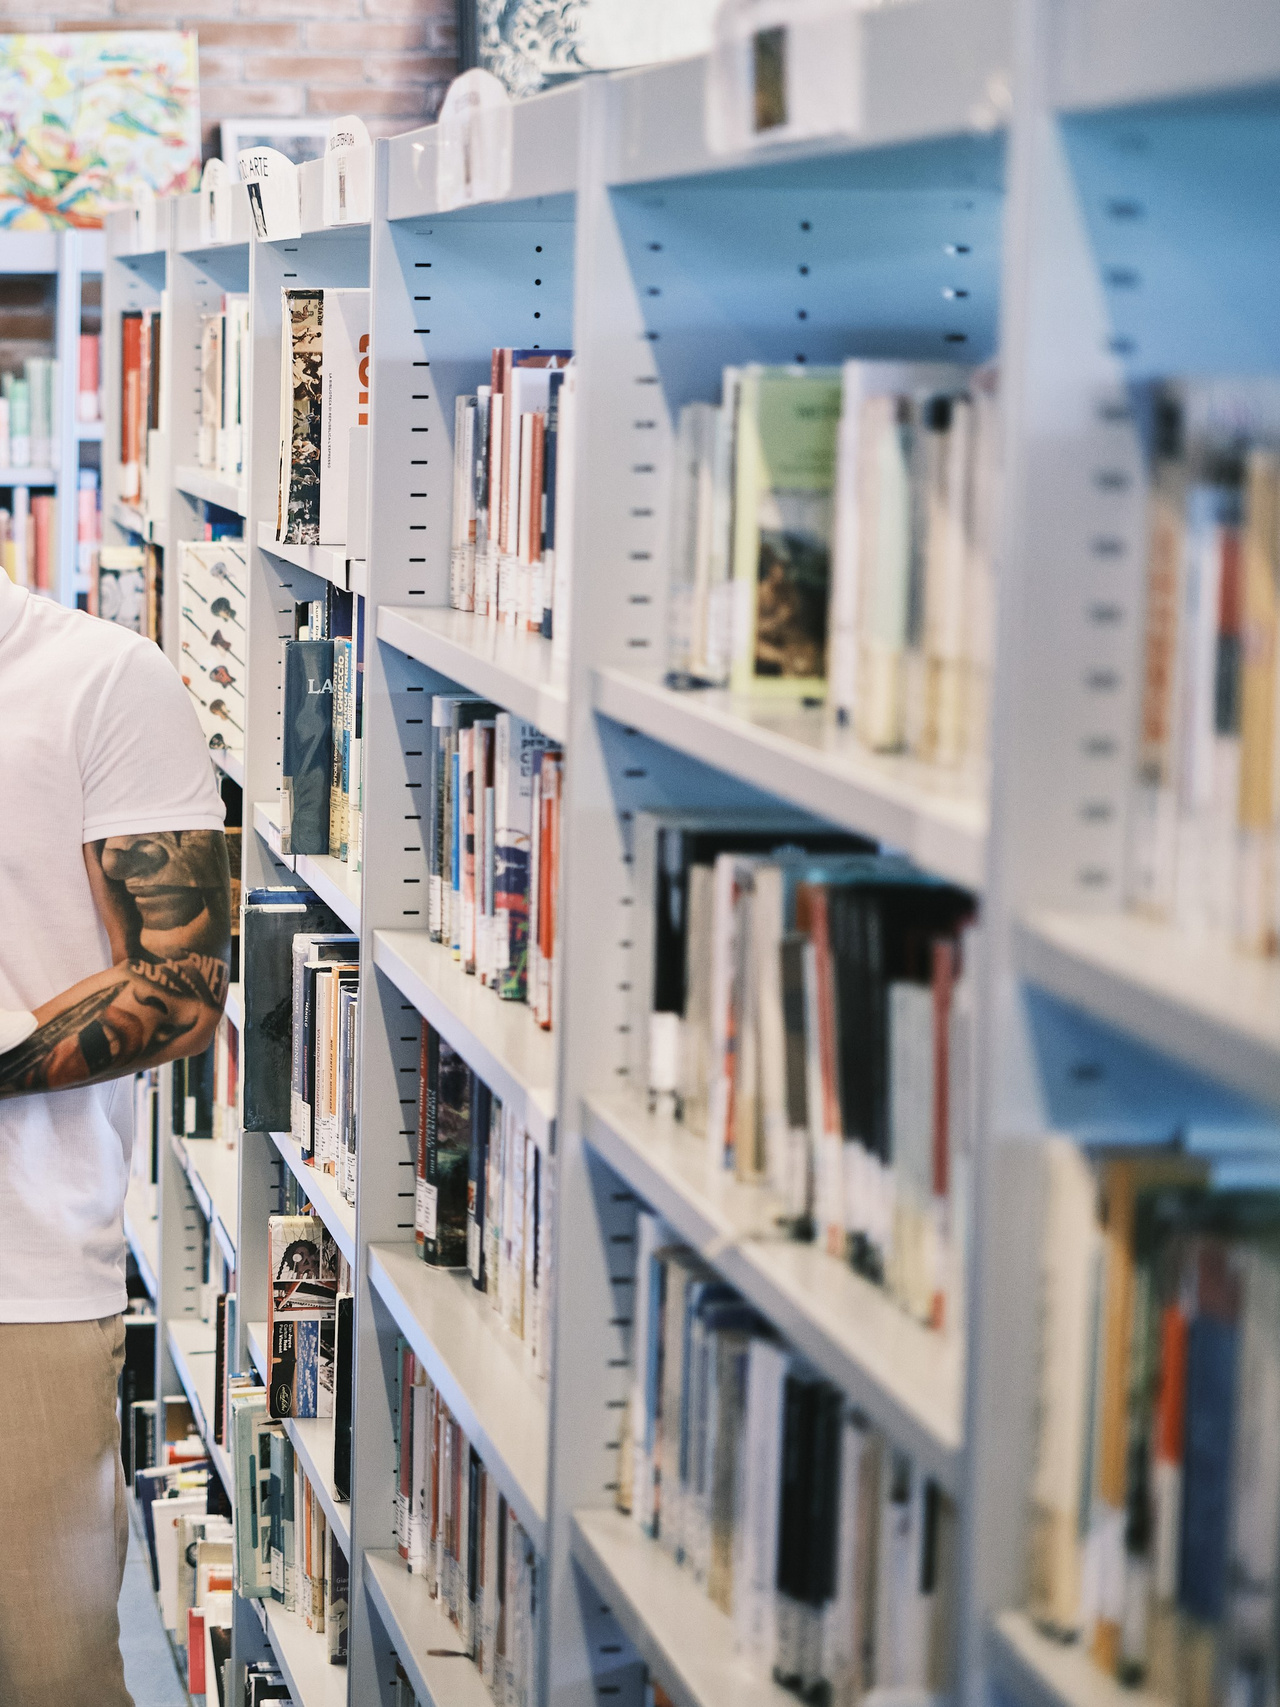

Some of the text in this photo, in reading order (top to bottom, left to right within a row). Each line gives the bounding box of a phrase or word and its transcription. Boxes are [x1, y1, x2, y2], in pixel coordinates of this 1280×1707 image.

[249, 157, 269, 177] ARTE
[307, 678, 334, 695] LA
[336, 655, 345, 728] DI GHIACCIO
